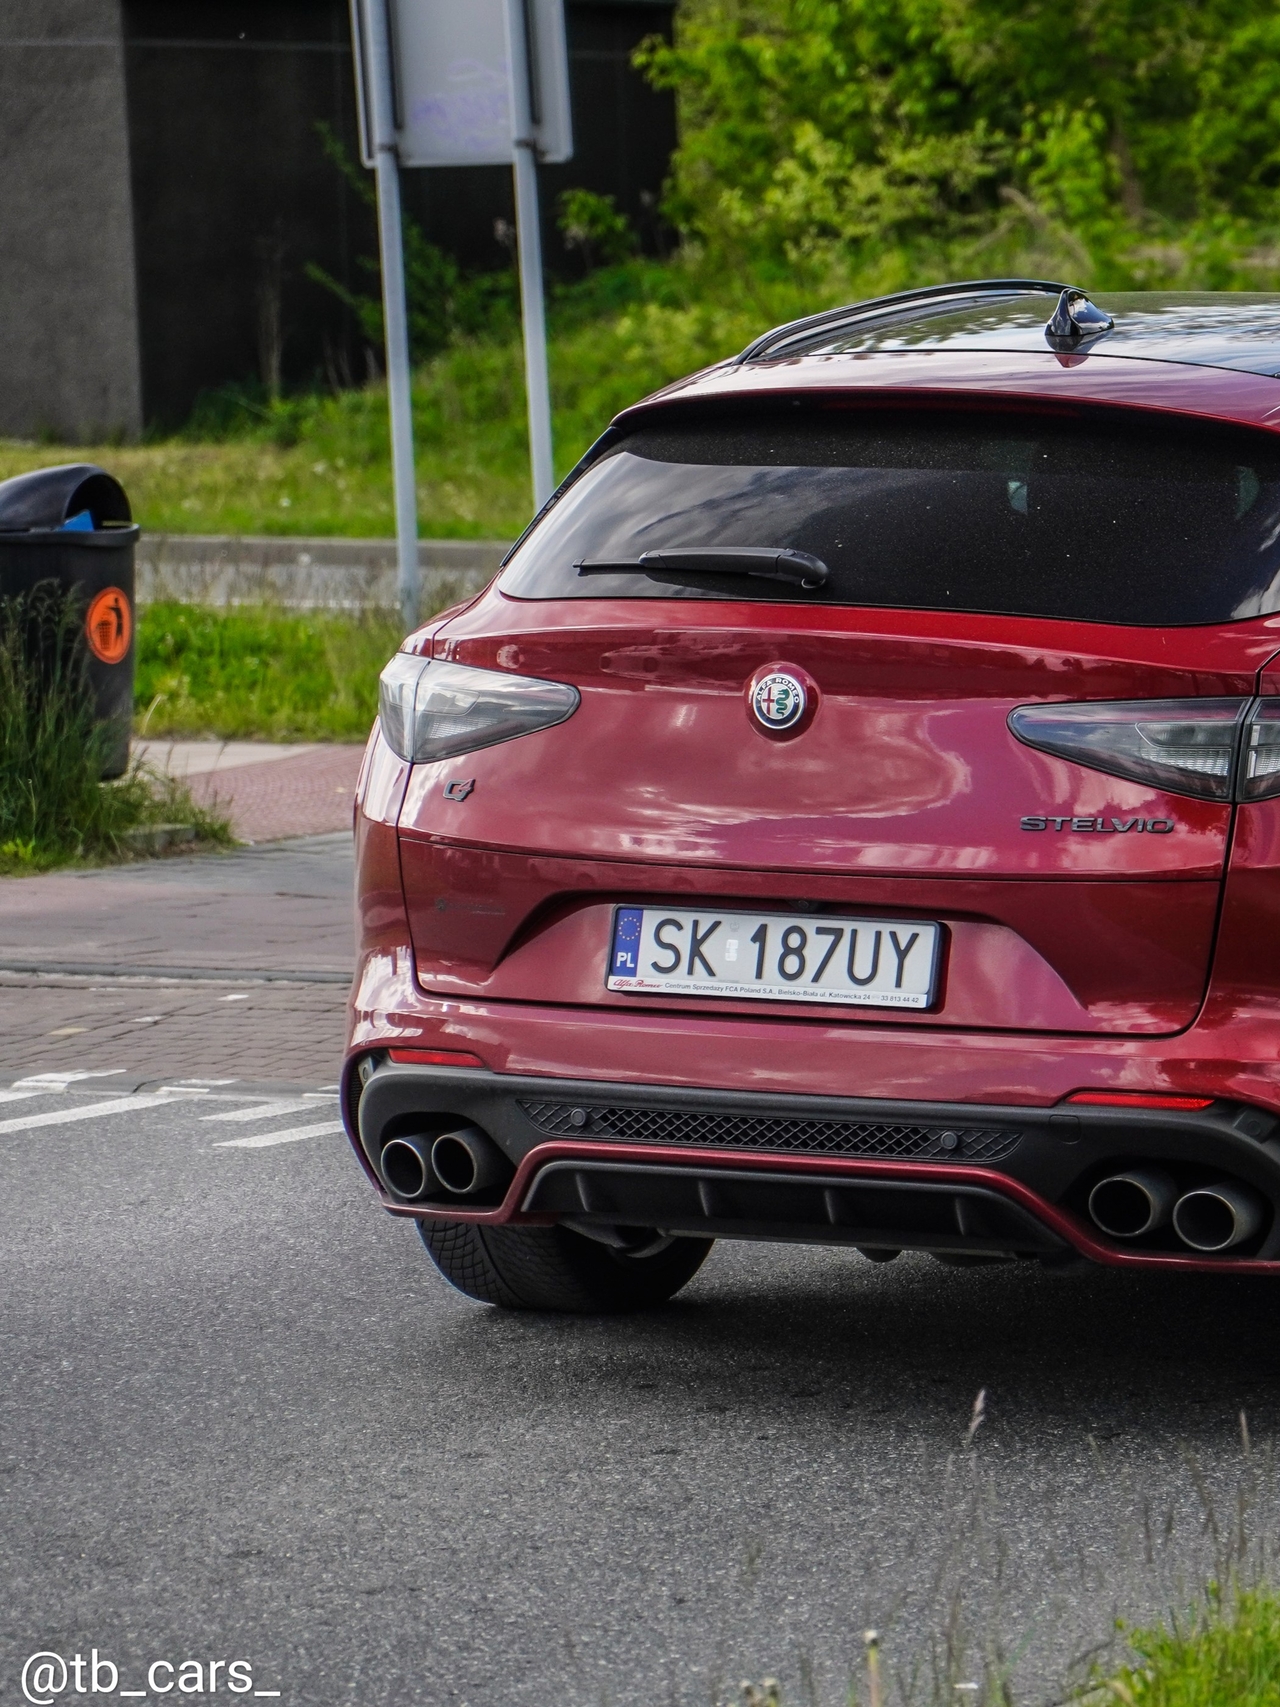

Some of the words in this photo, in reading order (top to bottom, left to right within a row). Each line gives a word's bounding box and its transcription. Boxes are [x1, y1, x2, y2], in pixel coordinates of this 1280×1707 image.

[756, 680, 773, 701] ALFA
[776, 678, 800, 703] ROMEO
[443, 779, 476, 802] Q4
[1020, 816, 1175, 833] STELVIO
[616, 952, 635, 968] PL
[650, 918, 722, 977] SK
[750, 923, 920, 989] 187UY
[613, 979, 632, 990] Alfa
[829, 992, 862, 1000] Katowicka
